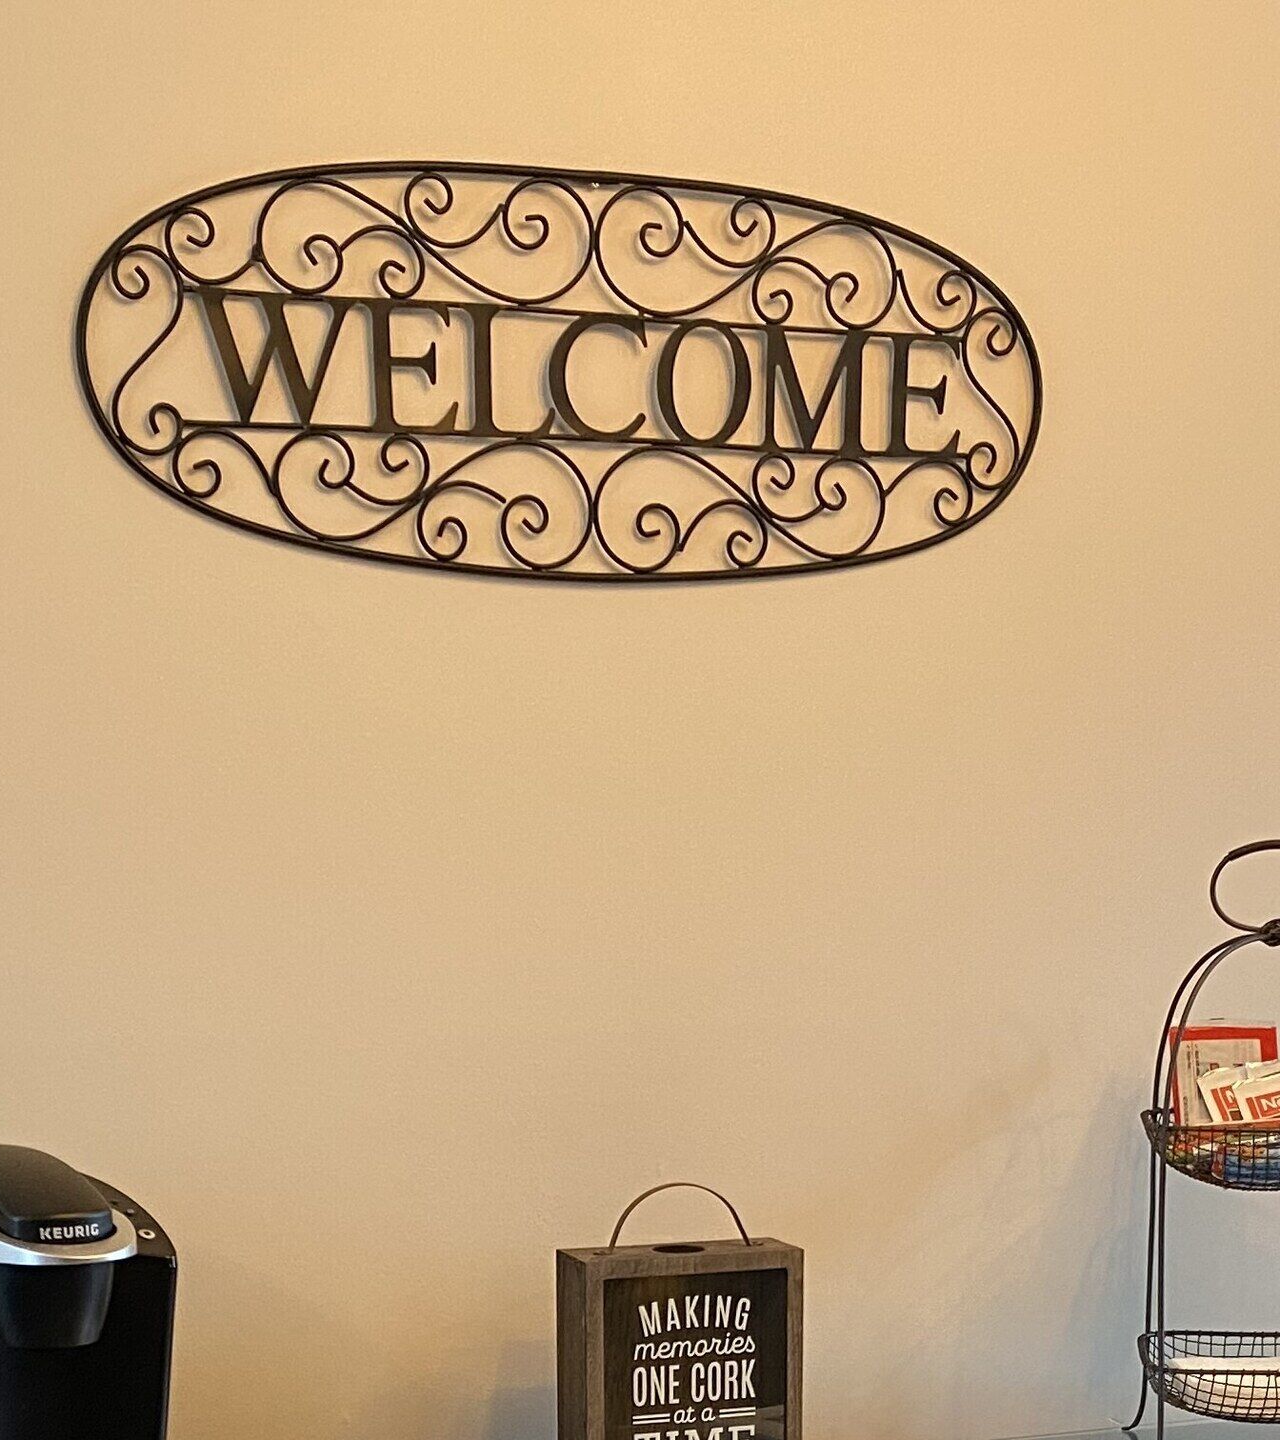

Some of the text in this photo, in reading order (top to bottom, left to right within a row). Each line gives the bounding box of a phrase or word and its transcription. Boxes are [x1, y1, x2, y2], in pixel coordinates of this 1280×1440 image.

[194, 286, 966, 460] WELCOME
[39, 1223, 100, 1240] KEURIG
[638, 1295, 751, 1337] MAKING
[634, 1333, 756, 1361] memories
[633, 1359, 756, 1407] ONE CORK
[674, 1407, 716, 1424] at a
